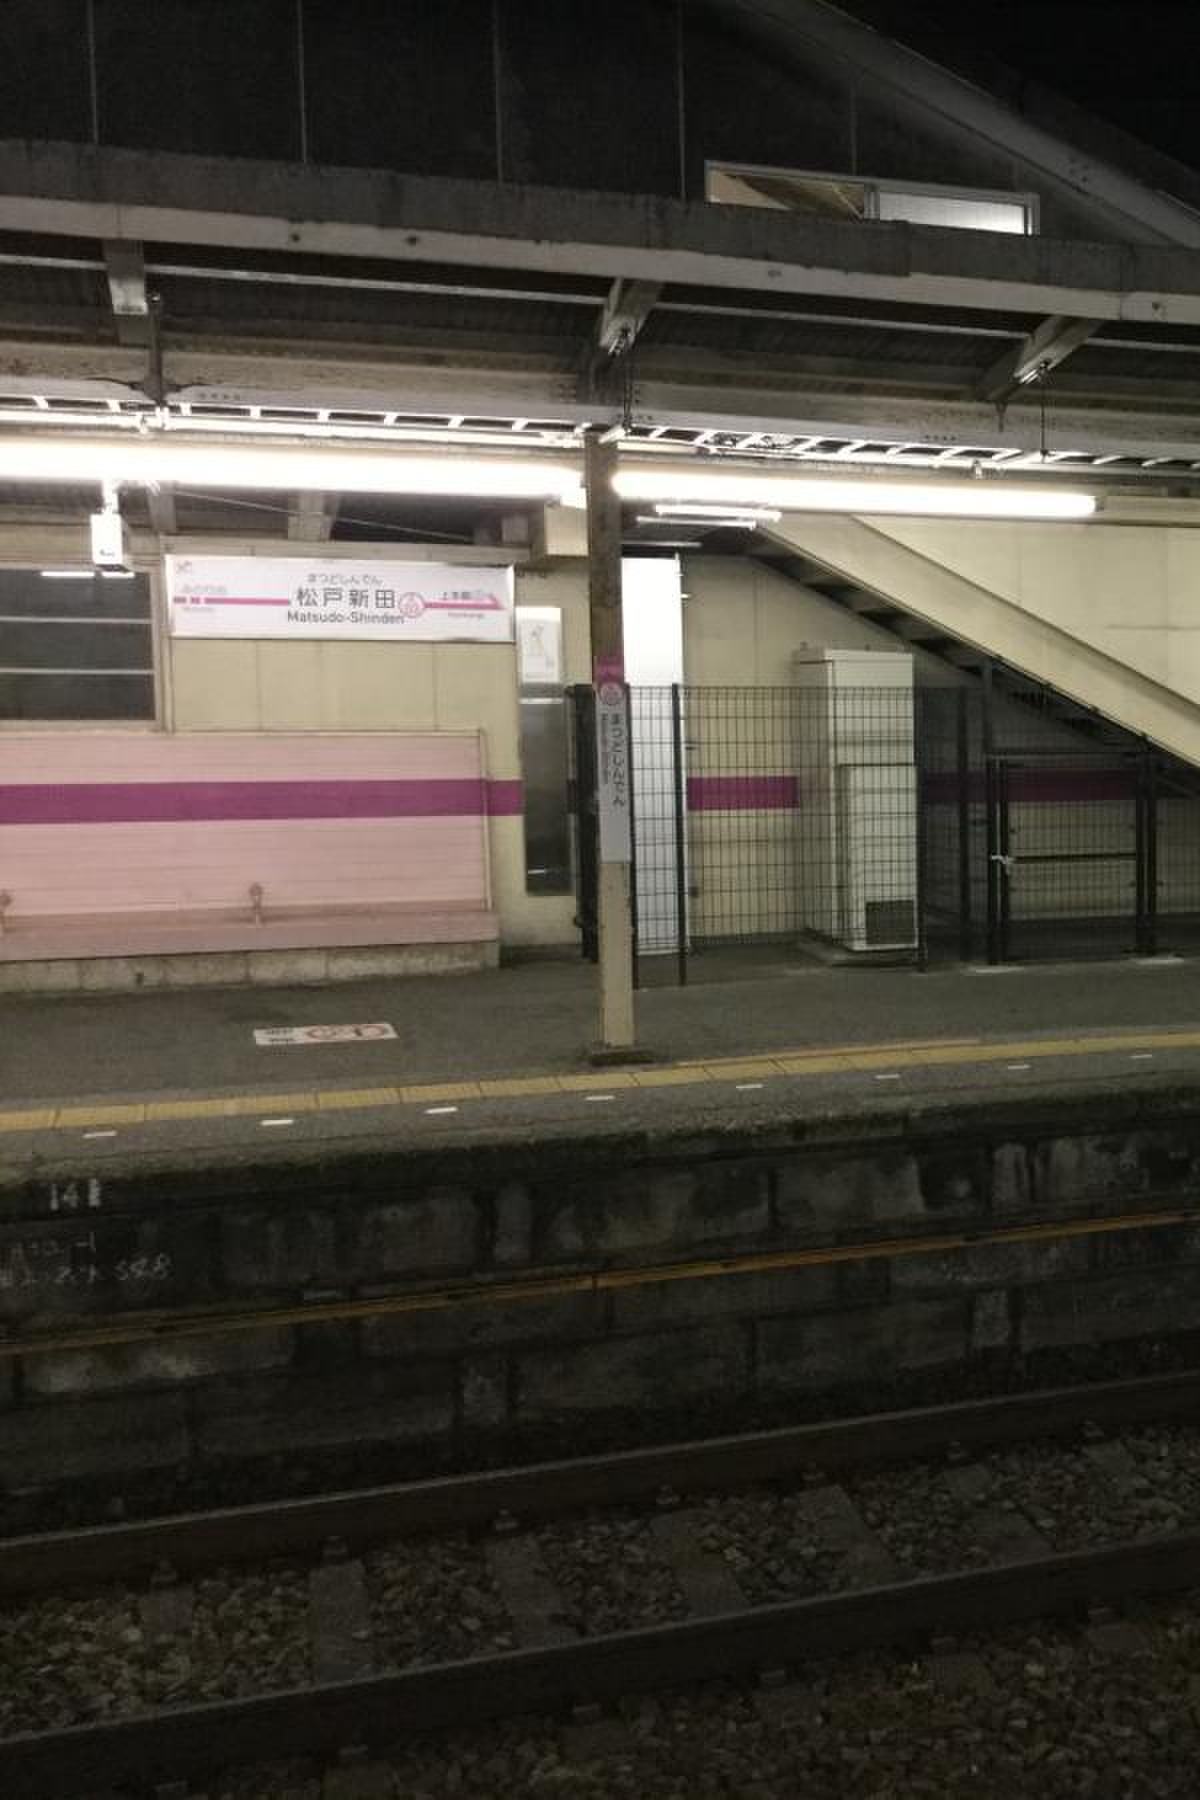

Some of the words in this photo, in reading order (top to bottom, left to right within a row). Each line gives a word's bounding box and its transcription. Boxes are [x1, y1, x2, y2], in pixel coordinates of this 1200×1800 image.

[296, 587, 395, 609] 松戸新田
[287, 610, 405, 625] Matsudo-Shinden
